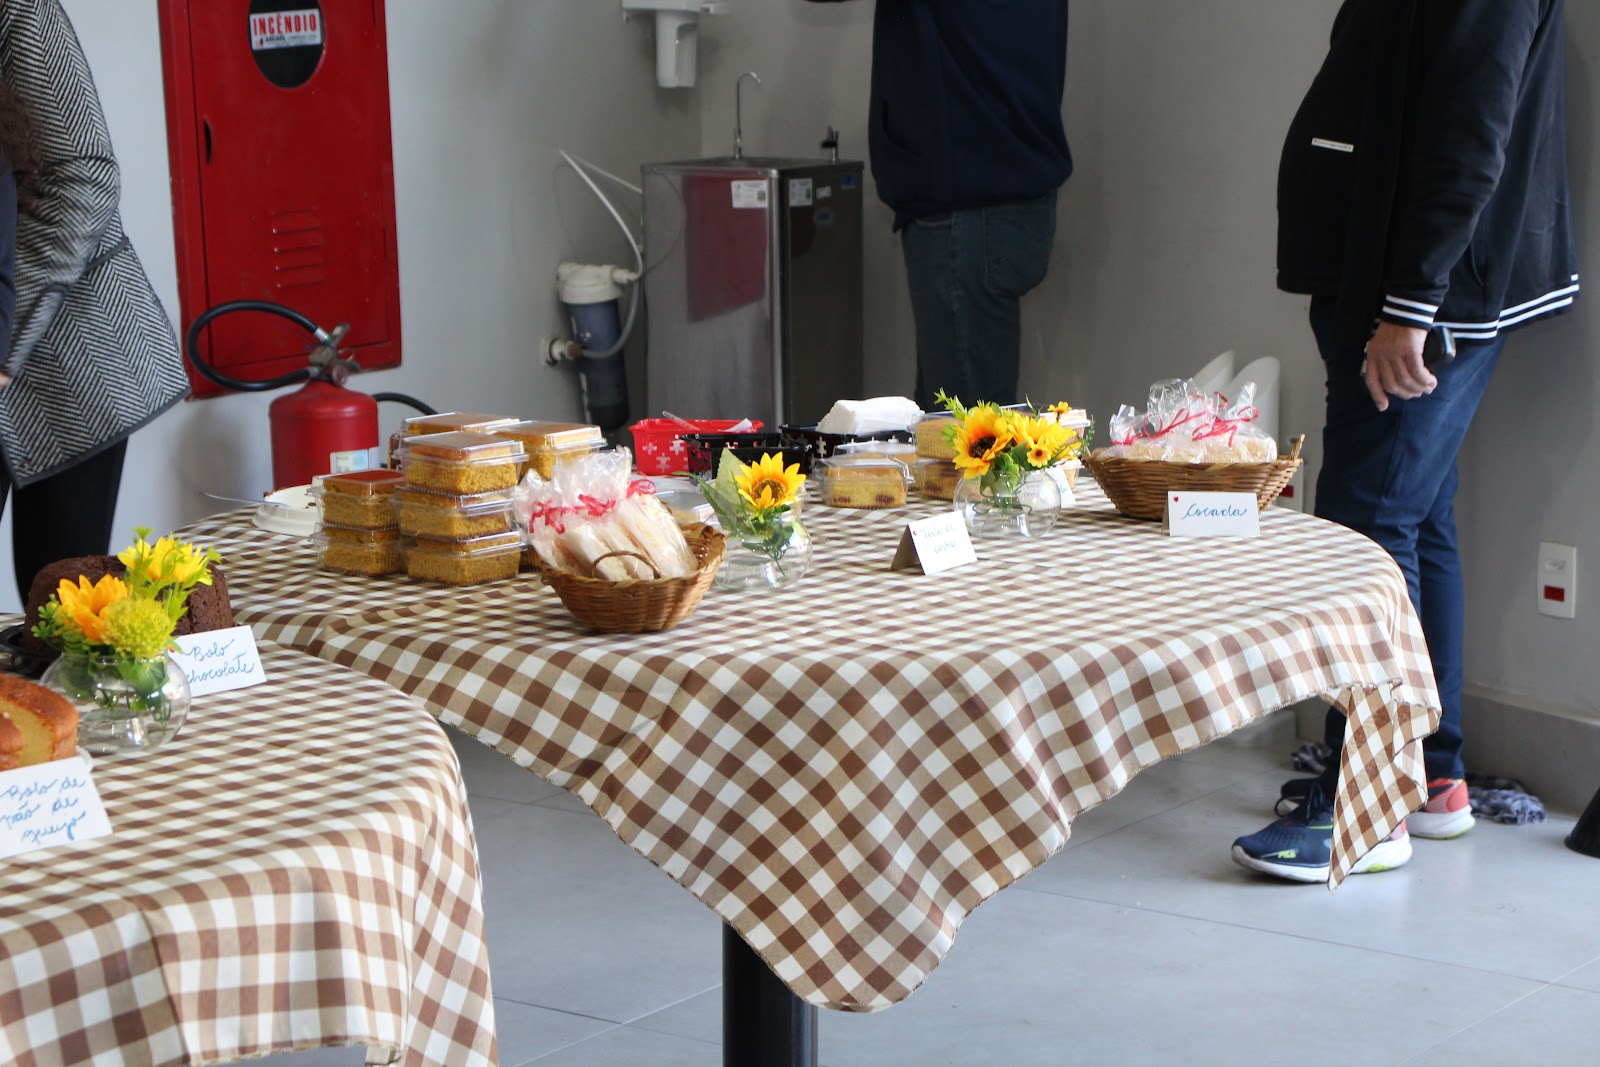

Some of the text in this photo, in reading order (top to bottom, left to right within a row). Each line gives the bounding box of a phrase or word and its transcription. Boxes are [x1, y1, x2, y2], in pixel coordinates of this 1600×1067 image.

[253, 12, 317, 36] INCÊNDIO
[1182, 503, 1248, 520] Cocada
[183, 638, 236, 662] Bolo
[59, 776, 86, 794] de
[52, 797, 79, 815] de
